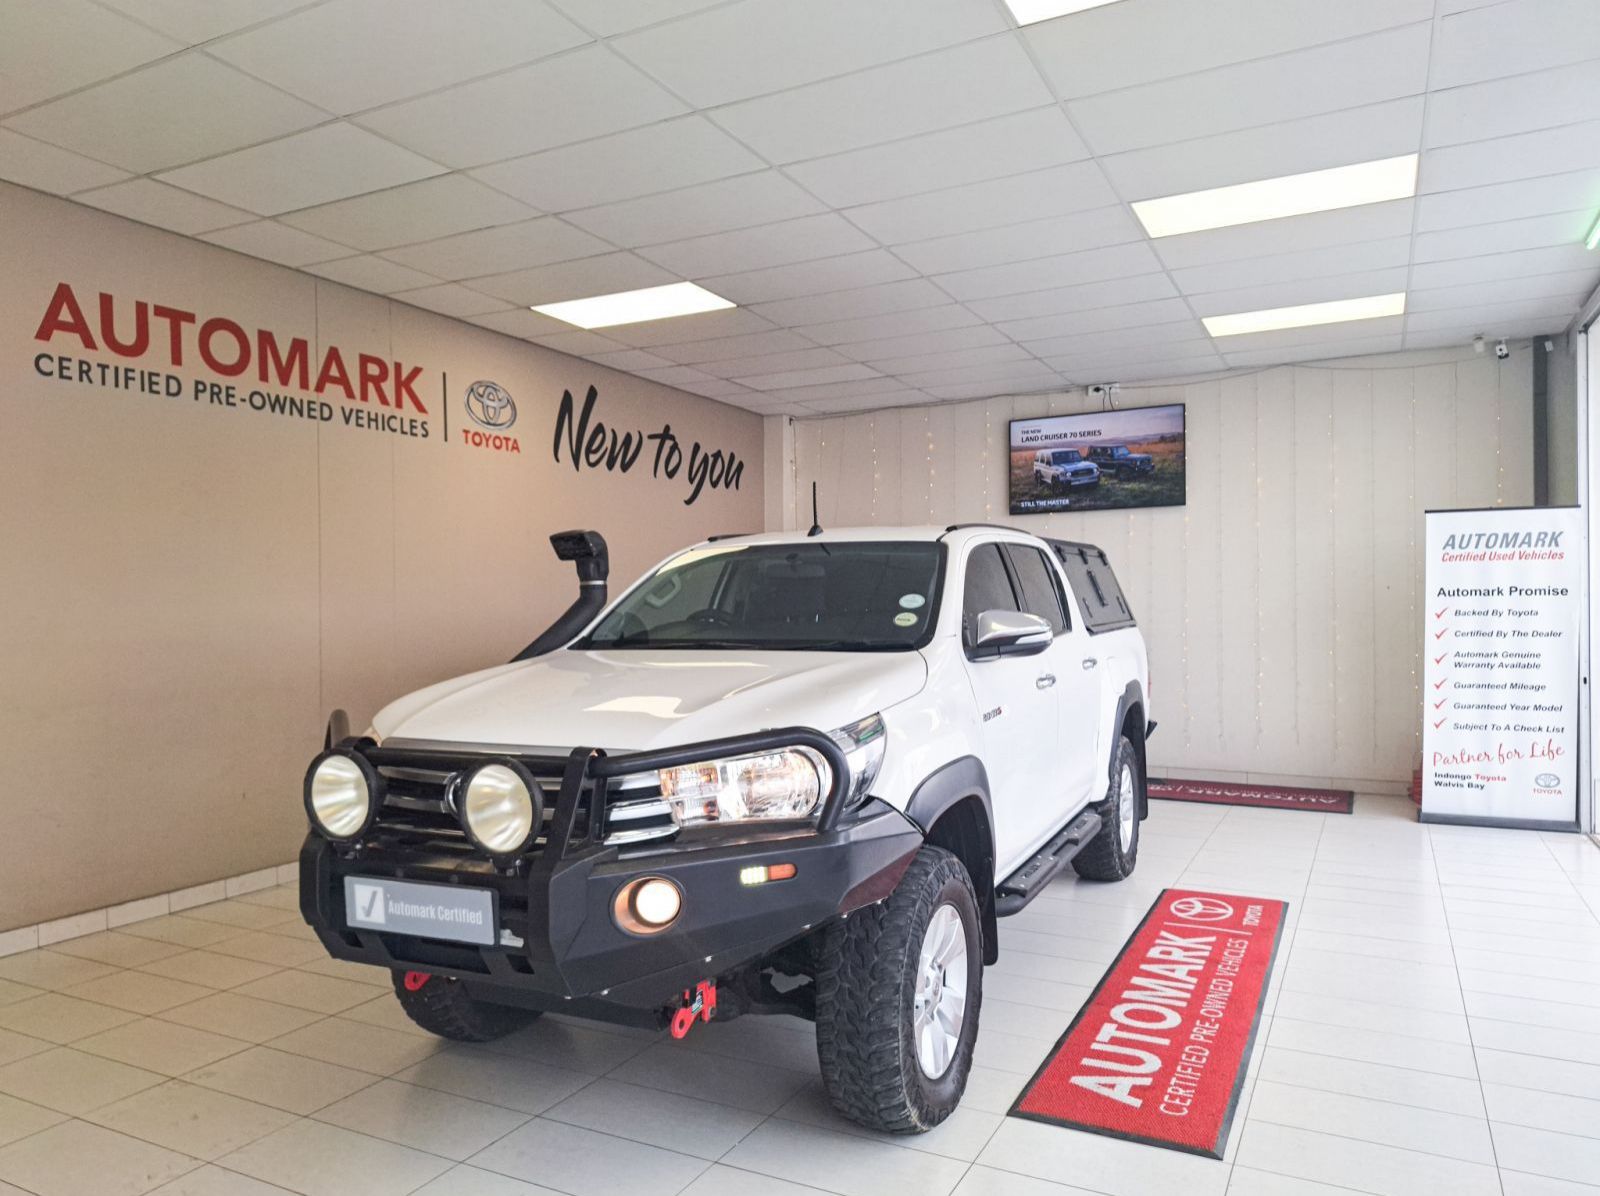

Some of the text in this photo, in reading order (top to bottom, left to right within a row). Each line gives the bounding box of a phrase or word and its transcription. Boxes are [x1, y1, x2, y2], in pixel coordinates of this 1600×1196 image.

[34, 282, 428, 414] AUTOMARK
[34, 353, 430, 438] CERTIFIED PRE-OWNED VEHICLES
[462, 429, 521, 454] TOYOTA
[1021, 435, 1040, 444] LAND
[1040, 432, 1068, 442] CRUISER
[1078, 429, 1102, 438] SERIES
[553, 385, 744, 505] New to you
[1047, 498, 1070, 506] MASTER
[1442, 531, 1564, 550] AUTOMARK
[1441, 549, 1565, 563] Certified Used Vehicles
[1437, 585, 1569, 598] Automark Promise
[1454, 608, 1539, 618] Backed By Toyota
[1454, 629, 1563, 639] Certified By The Dealer
[1454, 650, 1541, 659] Automark Genuine
[1454, 662, 1541, 670] Warranty Available
[1453, 682, 1547, 692] Guaranteed Mileage
[1453, 702, 1563, 713] Guaranteed Year Model
[1453, 723, 1565, 734] Subject To A Check List
[1433, 738, 1565, 767] Partner for Life
[1434, 772, 1507, 782] Indongo Toyota
[1434, 780, 1485, 790] Walvis Bay
[1533, 787, 1562, 795] TOYOTA
[388, 901, 483, 925] Automark Certified
[1242, 904, 1264, 927] TOYOTA
[1068, 930, 1217, 1110] AUTOMARK
[1159, 938, 1249, 1117] CERTIFIED PRE-OWNED VEHICLES
